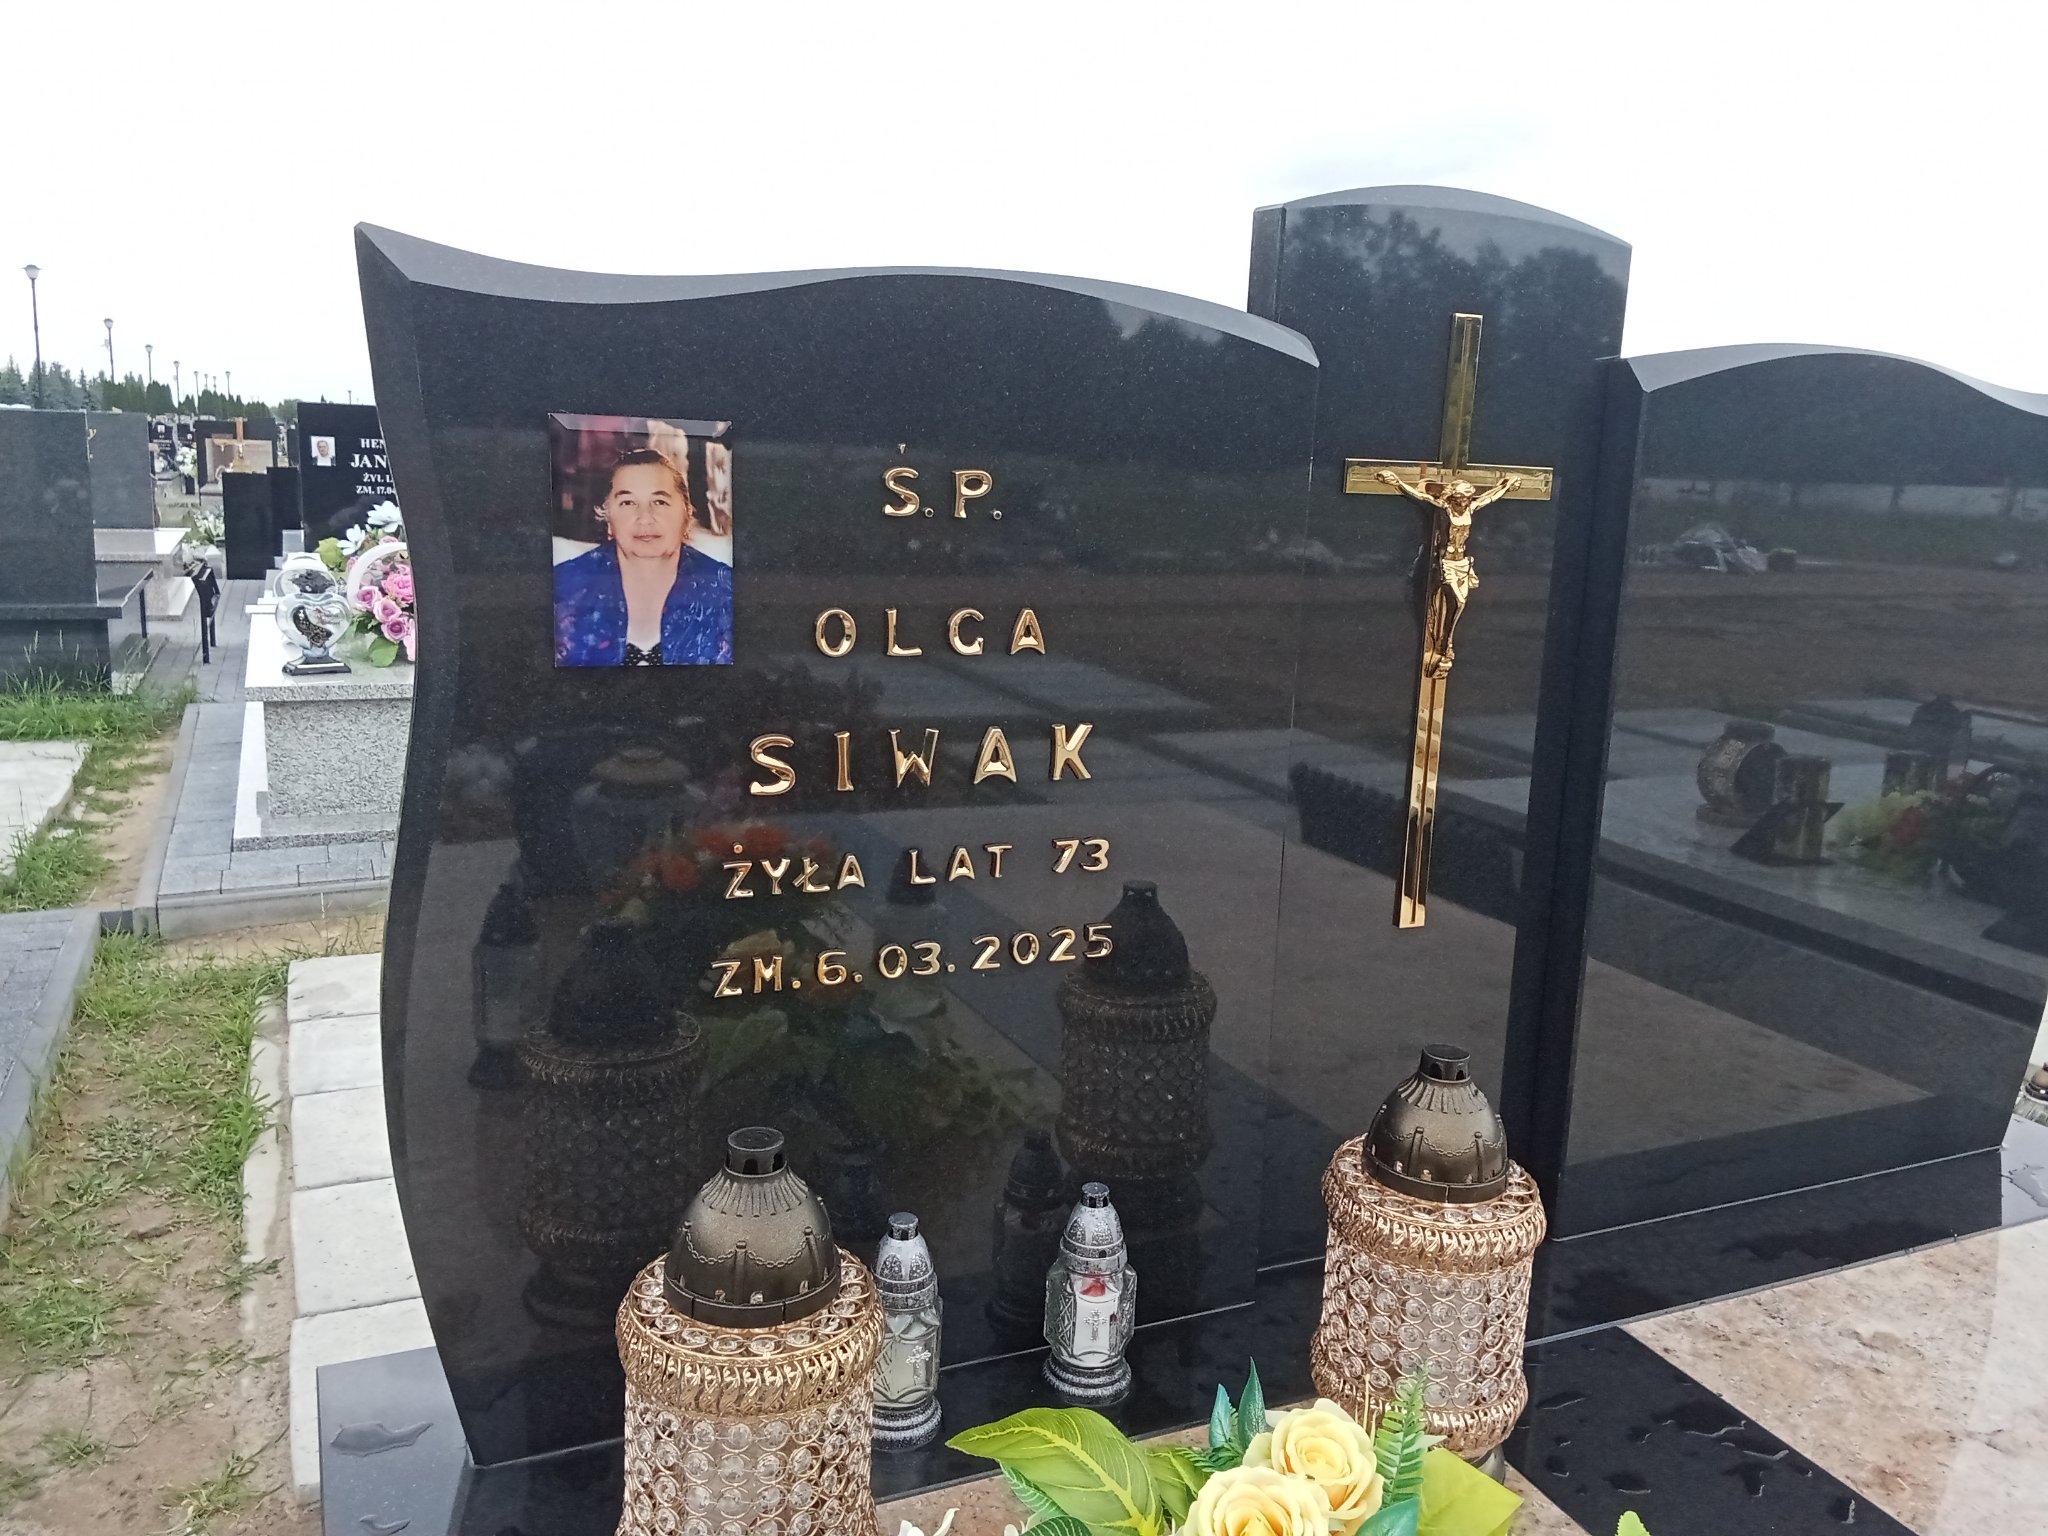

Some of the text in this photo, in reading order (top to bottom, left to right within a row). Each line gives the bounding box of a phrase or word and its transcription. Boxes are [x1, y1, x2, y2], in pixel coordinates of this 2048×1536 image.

[350, 453, 387, 468] JAN
[814, 607, 1046, 658] OLGA
[749, 723, 1094, 796] SIWAK
[723, 837, 1110, 900] ŻYŁA LAT 73
